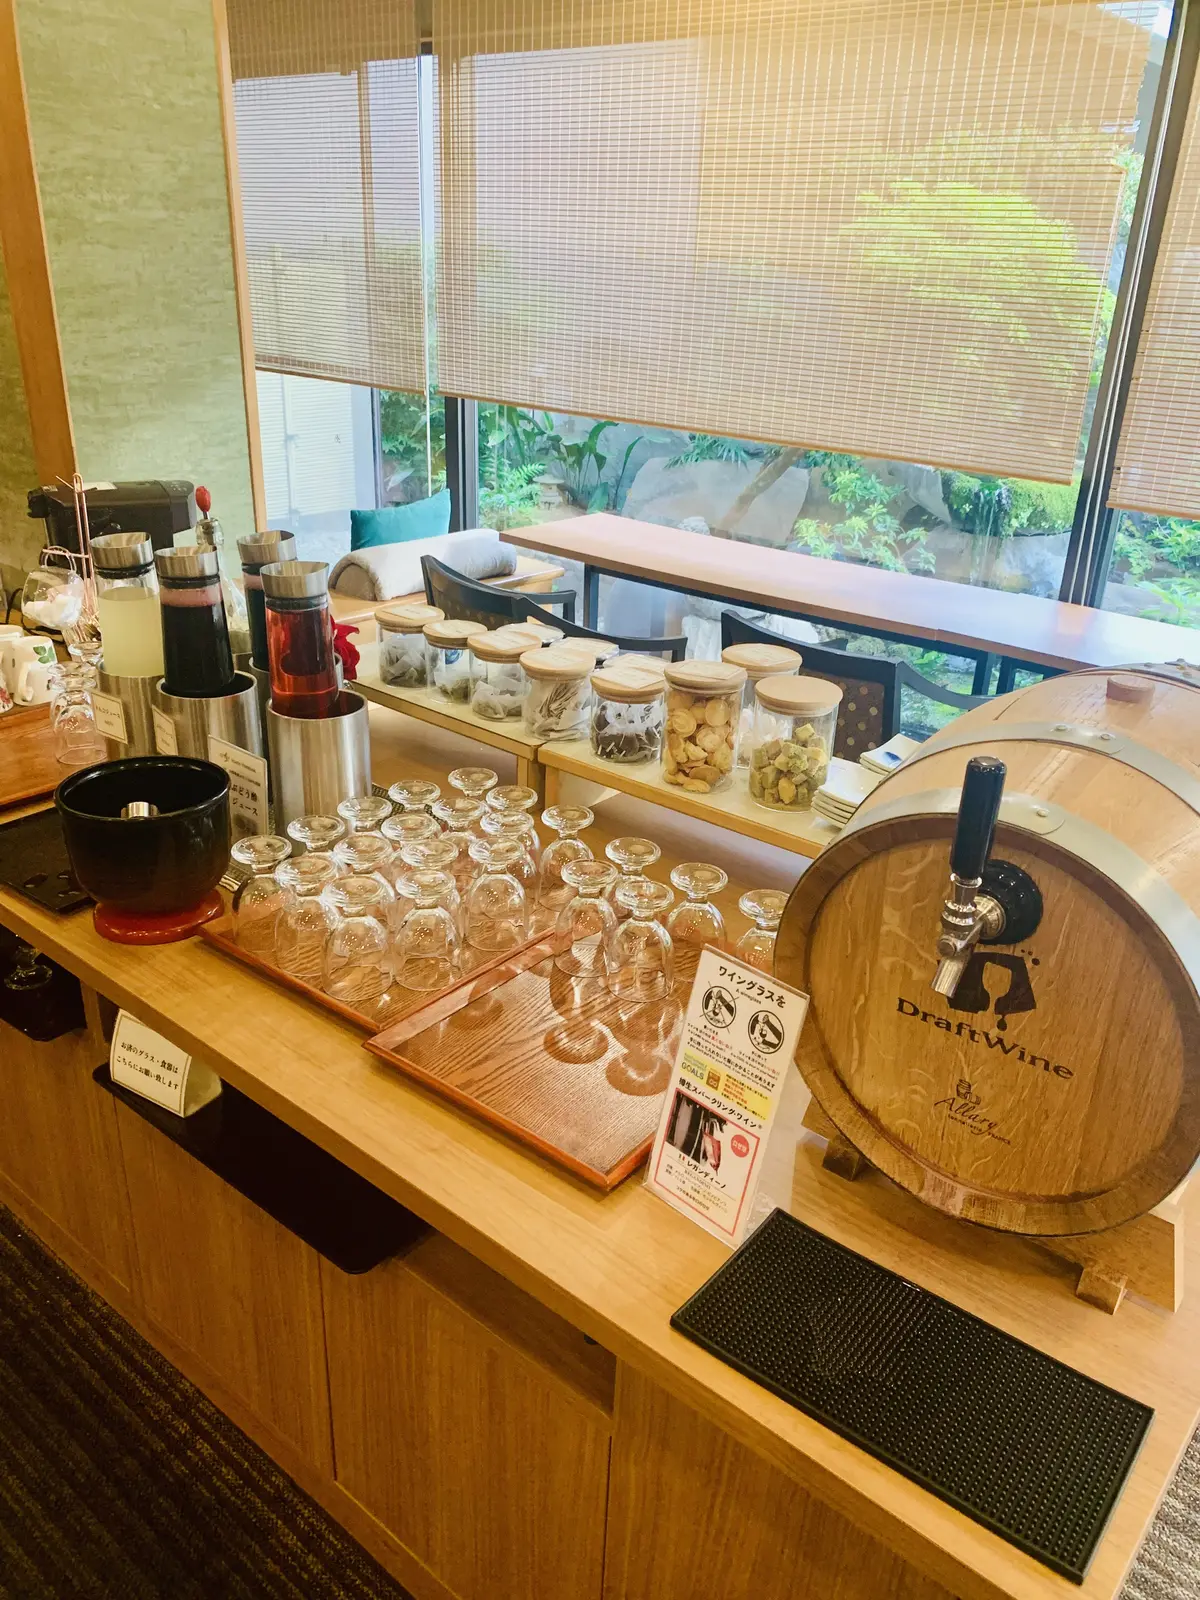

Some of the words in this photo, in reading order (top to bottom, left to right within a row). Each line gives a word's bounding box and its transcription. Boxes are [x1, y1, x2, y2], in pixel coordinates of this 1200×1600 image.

[232, 798, 259, 816] ジュース
[718, 965, 787, 1009] ワイングラスを
[896, 997, 1074, 1080] DraftWine
[116, 1056, 179, 1089] こちらにお願い致します
[121, 1042, 178, 1073] お済のグラス・食器は
[680, 1060, 705, 1081] GOALS
[934, 1098, 998, 1135] Allary
[685, 1160, 727, 1190] レガンディーノ
